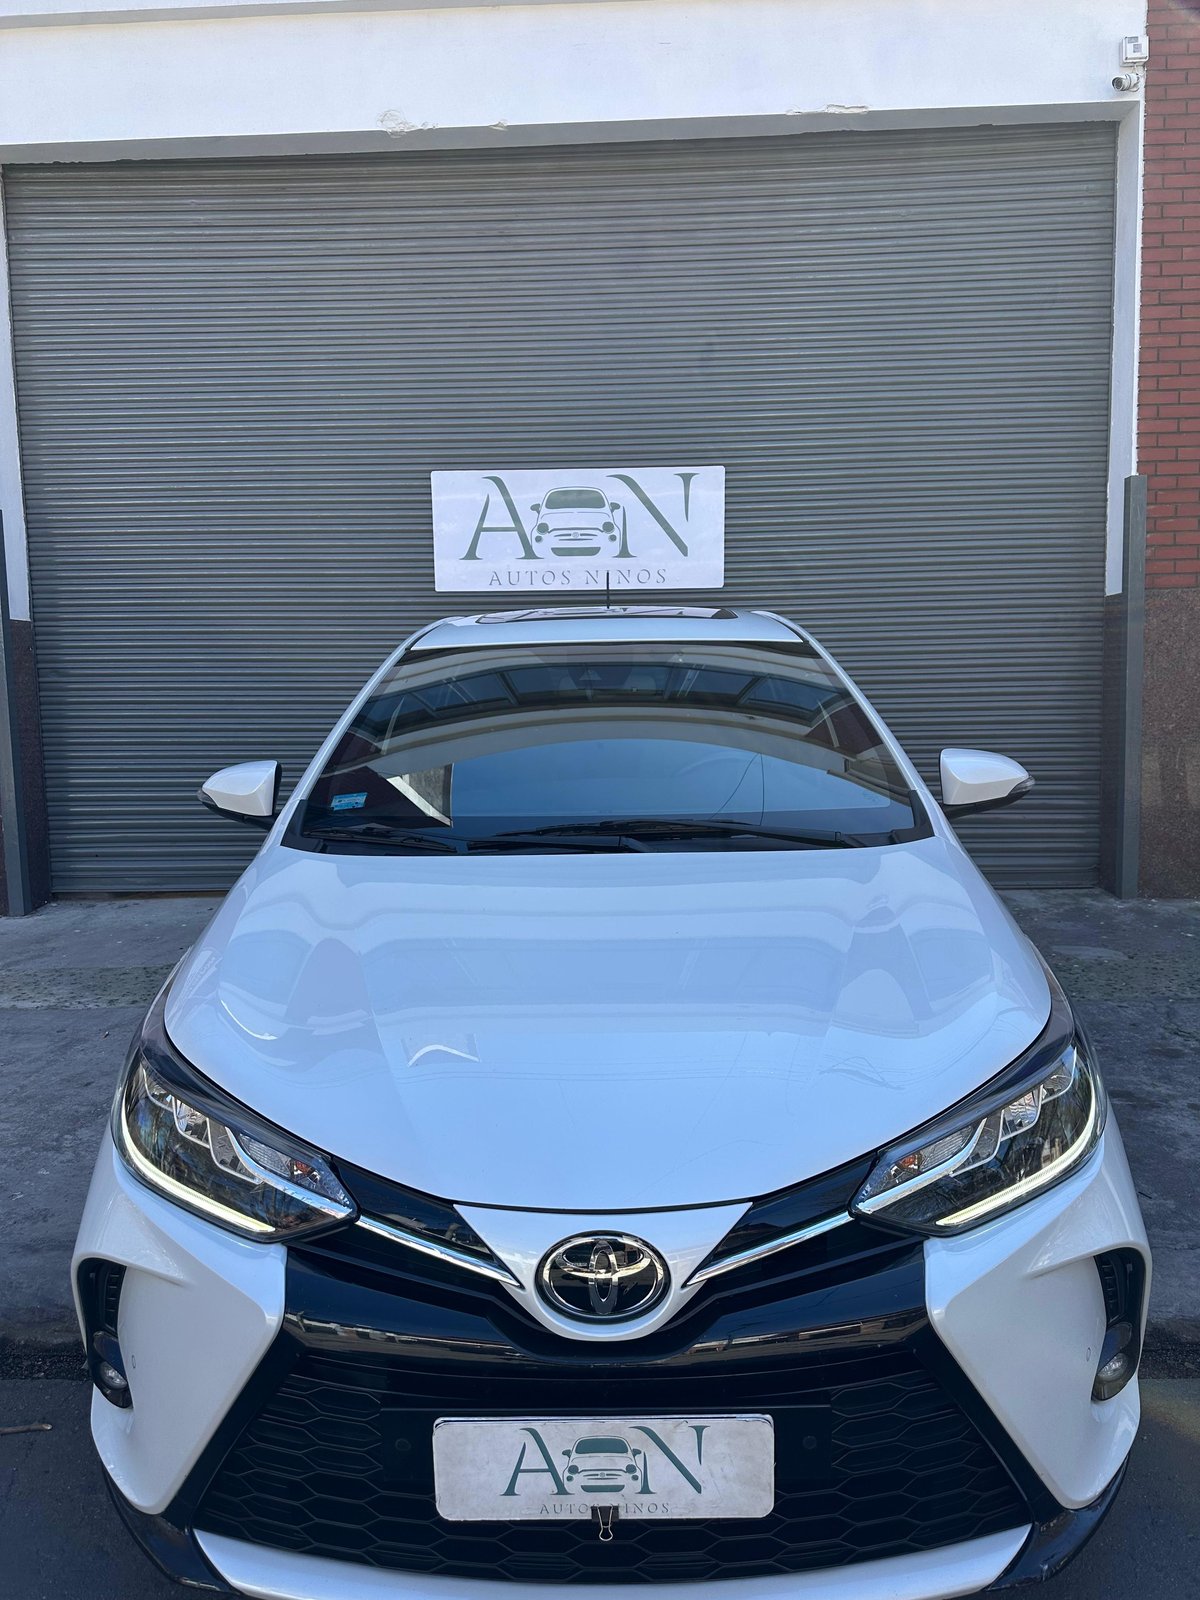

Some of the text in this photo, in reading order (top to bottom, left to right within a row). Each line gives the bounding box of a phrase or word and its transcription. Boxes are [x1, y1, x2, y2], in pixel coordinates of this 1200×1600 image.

[489, 569, 666, 586] AUTOS NNOS
[540, 1502, 669, 1514] AUTO INOS
